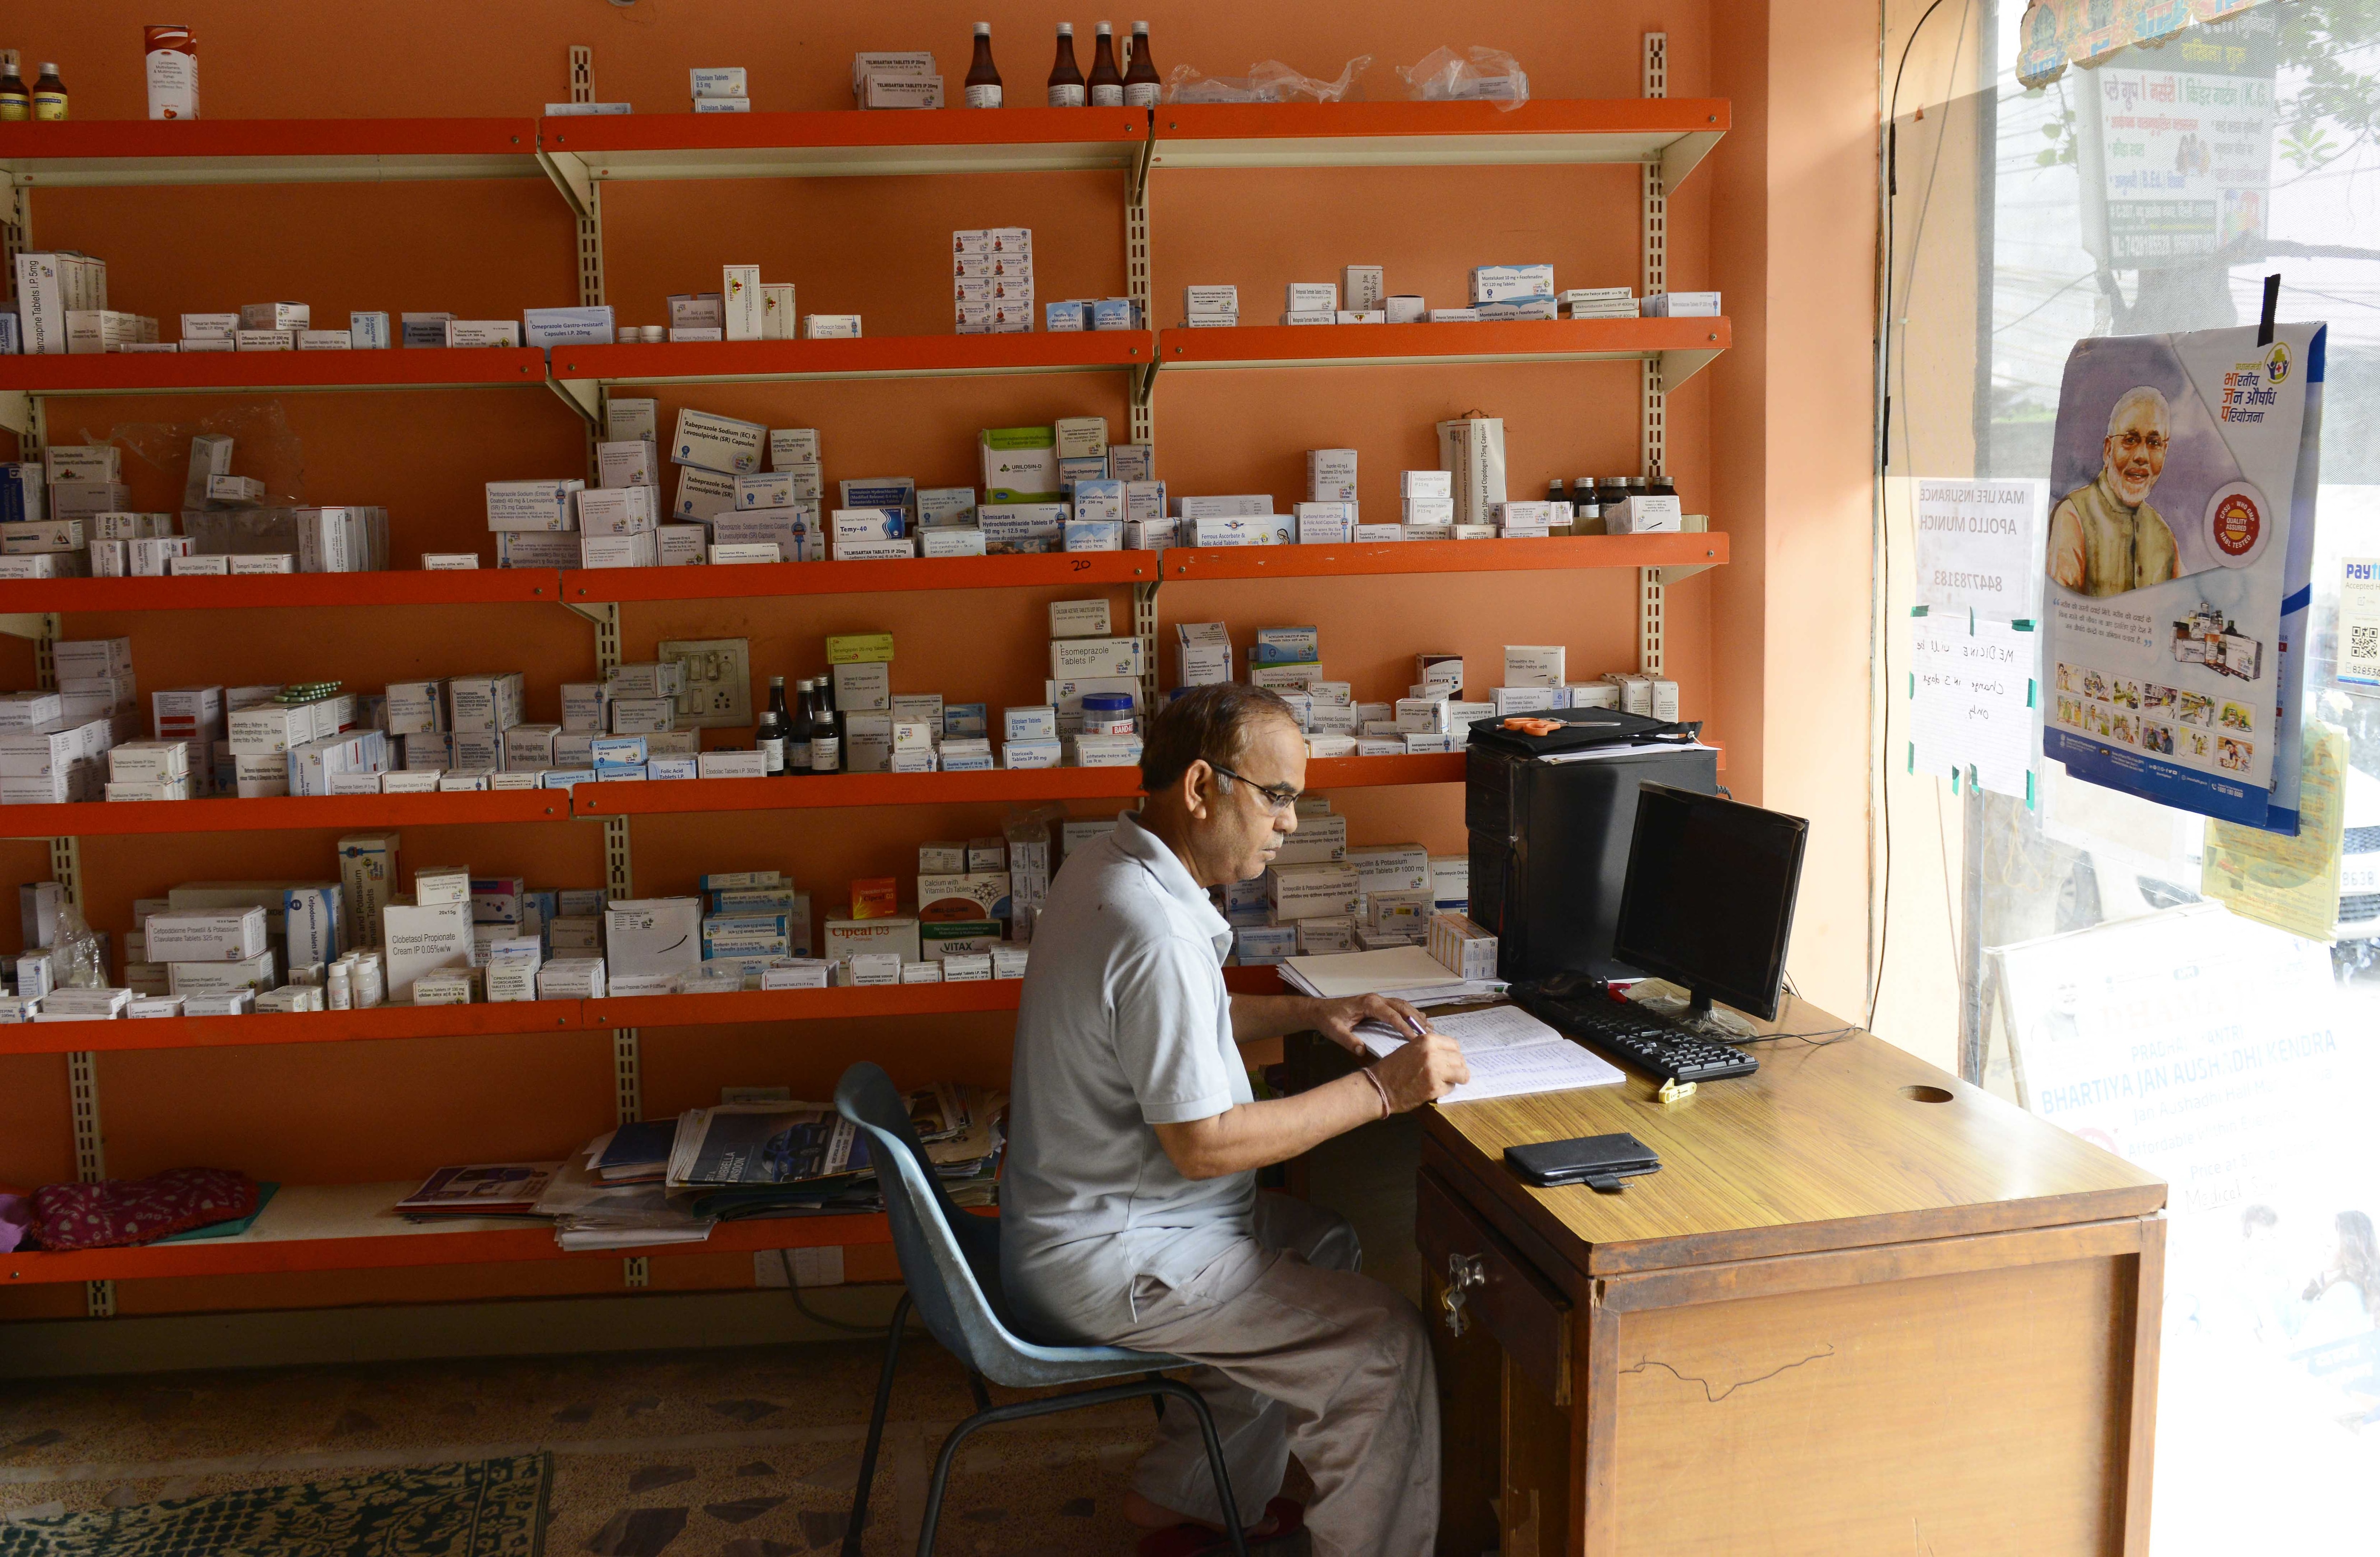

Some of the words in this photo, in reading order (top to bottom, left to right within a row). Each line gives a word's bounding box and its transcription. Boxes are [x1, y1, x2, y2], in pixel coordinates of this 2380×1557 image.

[30, 261, 39, 276] 5mg
[30, 278, 39, 288] I.P.
[32, 290, 40, 316] Tablets
[2235, 361, 2261, 370] प्रधानमंत्री
[2224, 372, 2260, 386] भारतीय
[2222, 388, 2244, 405] जन
[2246, 387, 2277, 405] औषधि
[2221, 406, 2265, 423] परियोजना
[685, 421, 717, 433] Rabeprazole
[718, 427, 738, 436] Sodium
[684, 429, 718, 441] Levosulpiride
[732, 439, 754, 448] Capsules
[687, 477, 720, 487] Rabeprazole
[686, 485, 721, 496] Levosulpiride
[2220, 504, 2231, 519] CPSU
[2237, 501, 2247, 509] WHO
[2220, 532, 2231, 546] NABL
[2233, 535, 2251, 548] TESTED
[1071, 560, 1091, 571] 20
[1061, 646, 1109, 656] Esomeprazole
[1061, 657, 1086, 665] Tablets
[392, 935, 422, 944] Clobetasol
[425, 933, 456, 943] Propionate
[944, 942, 972, 951] VITAX
[2042, 1074, 2133, 1114] BHARTIYA
[2138, 1063, 2169, 1099] JAN
[2266, 1030, 2337, 1064] KENDRA
[2133, 1105, 2155, 1126] Jan
[2129, 1132, 2194, 1159] Affordable
[2191, 1161, 2222, 1180] Price
[2185, 1180, 2244, 1209] Medical
